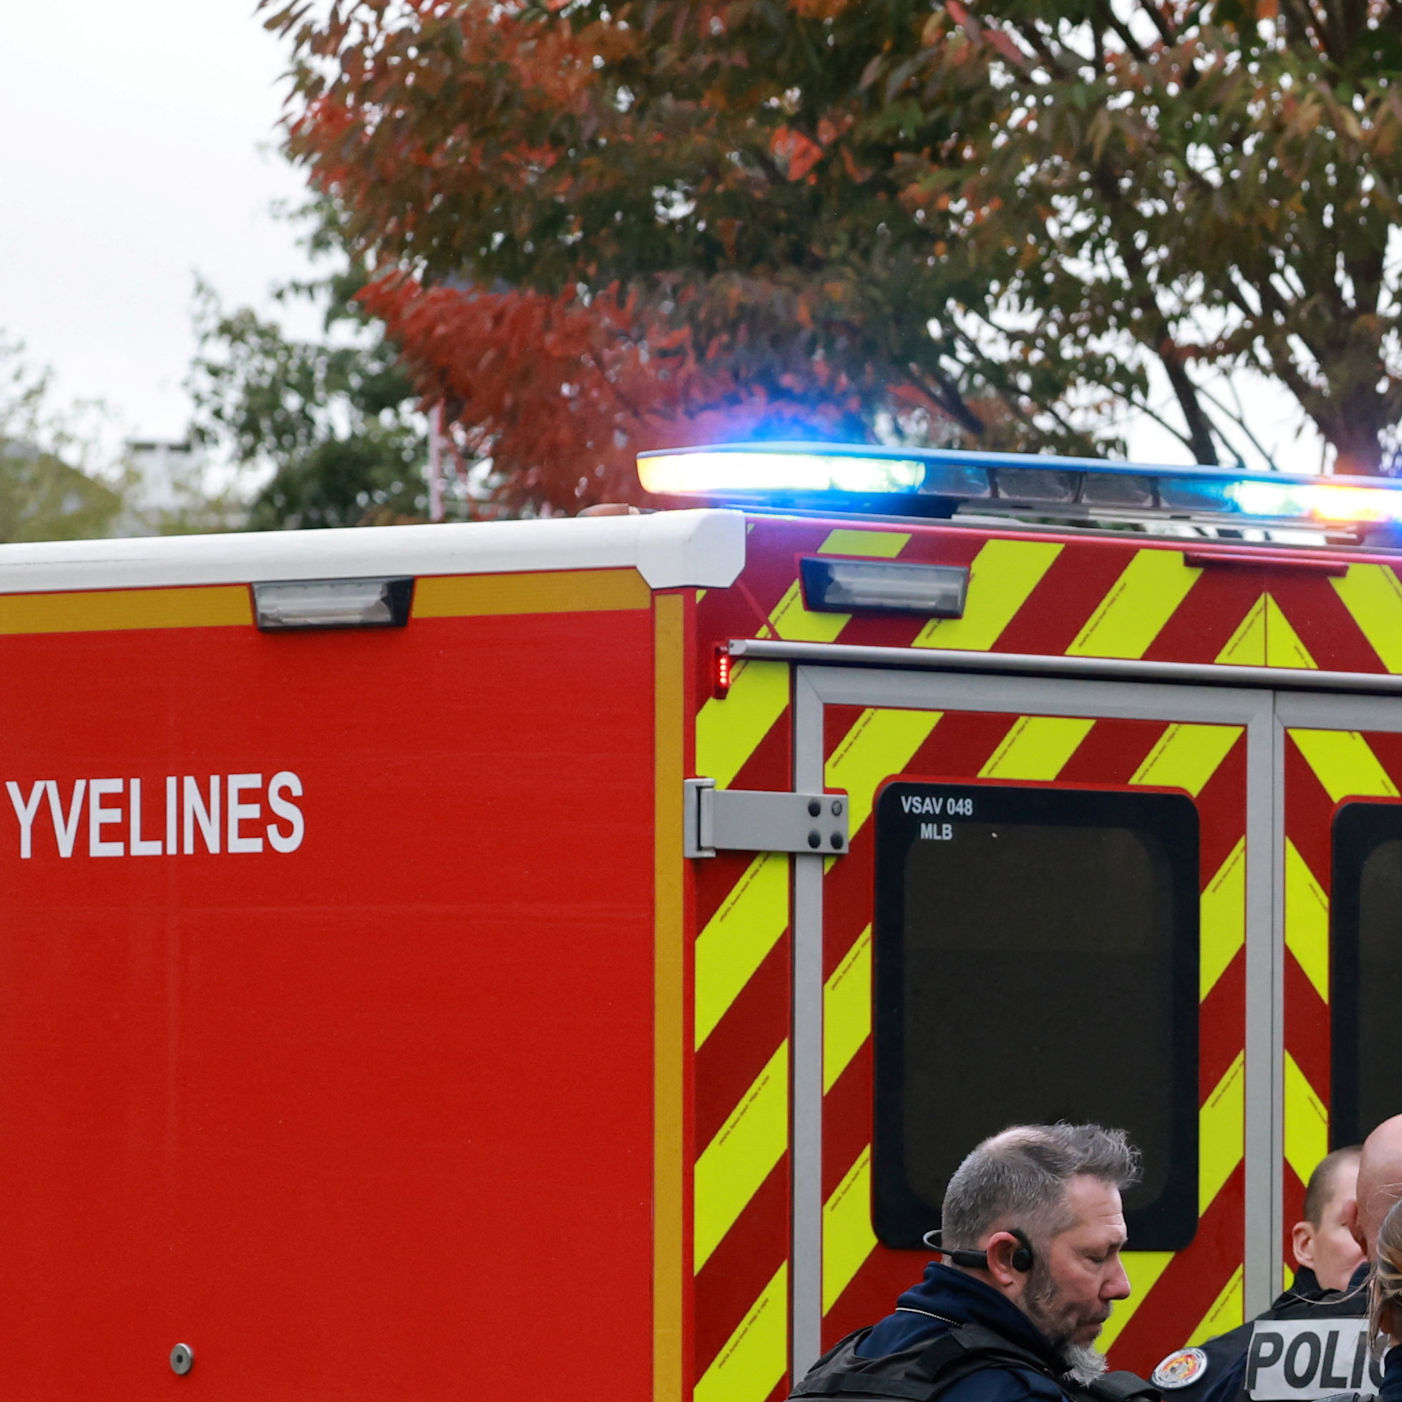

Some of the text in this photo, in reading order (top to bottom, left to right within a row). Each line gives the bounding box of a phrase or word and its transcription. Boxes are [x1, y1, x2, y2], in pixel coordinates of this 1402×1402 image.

[4, 770, 305, 859] YVELINES
[900, 795, 974, 816] VSAV 048
[920, 822, 953, 841] MLB
